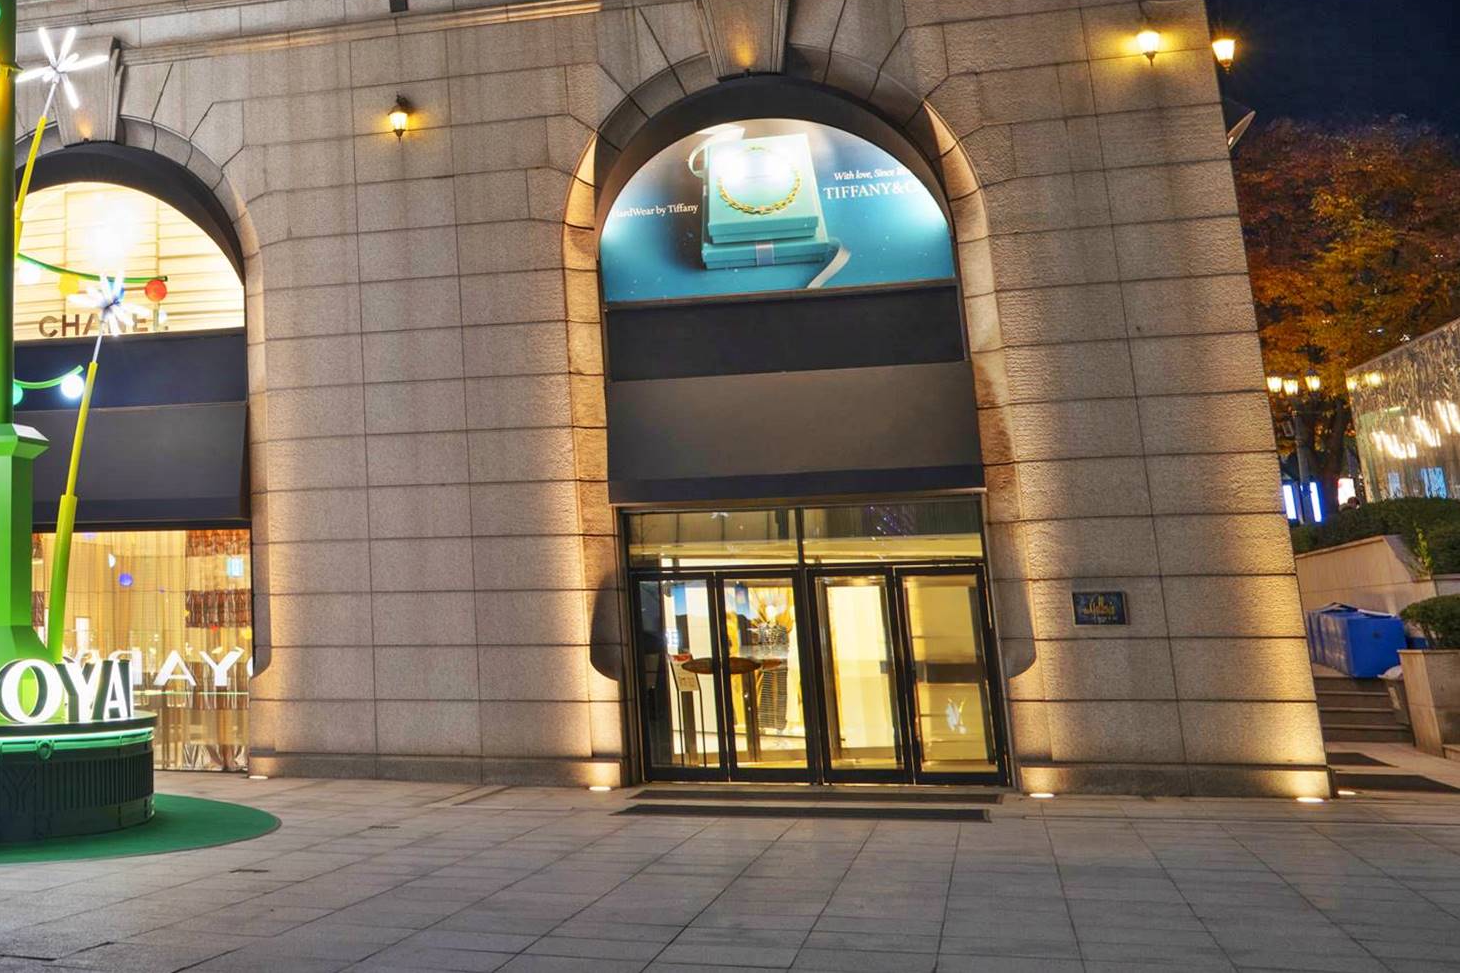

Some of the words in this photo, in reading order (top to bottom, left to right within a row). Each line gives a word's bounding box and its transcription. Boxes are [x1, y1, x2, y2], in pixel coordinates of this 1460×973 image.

[834, 171, 855, 181] With
[656, 206, 666, 217] by
[668, 203, 699, 214] Tiffany
